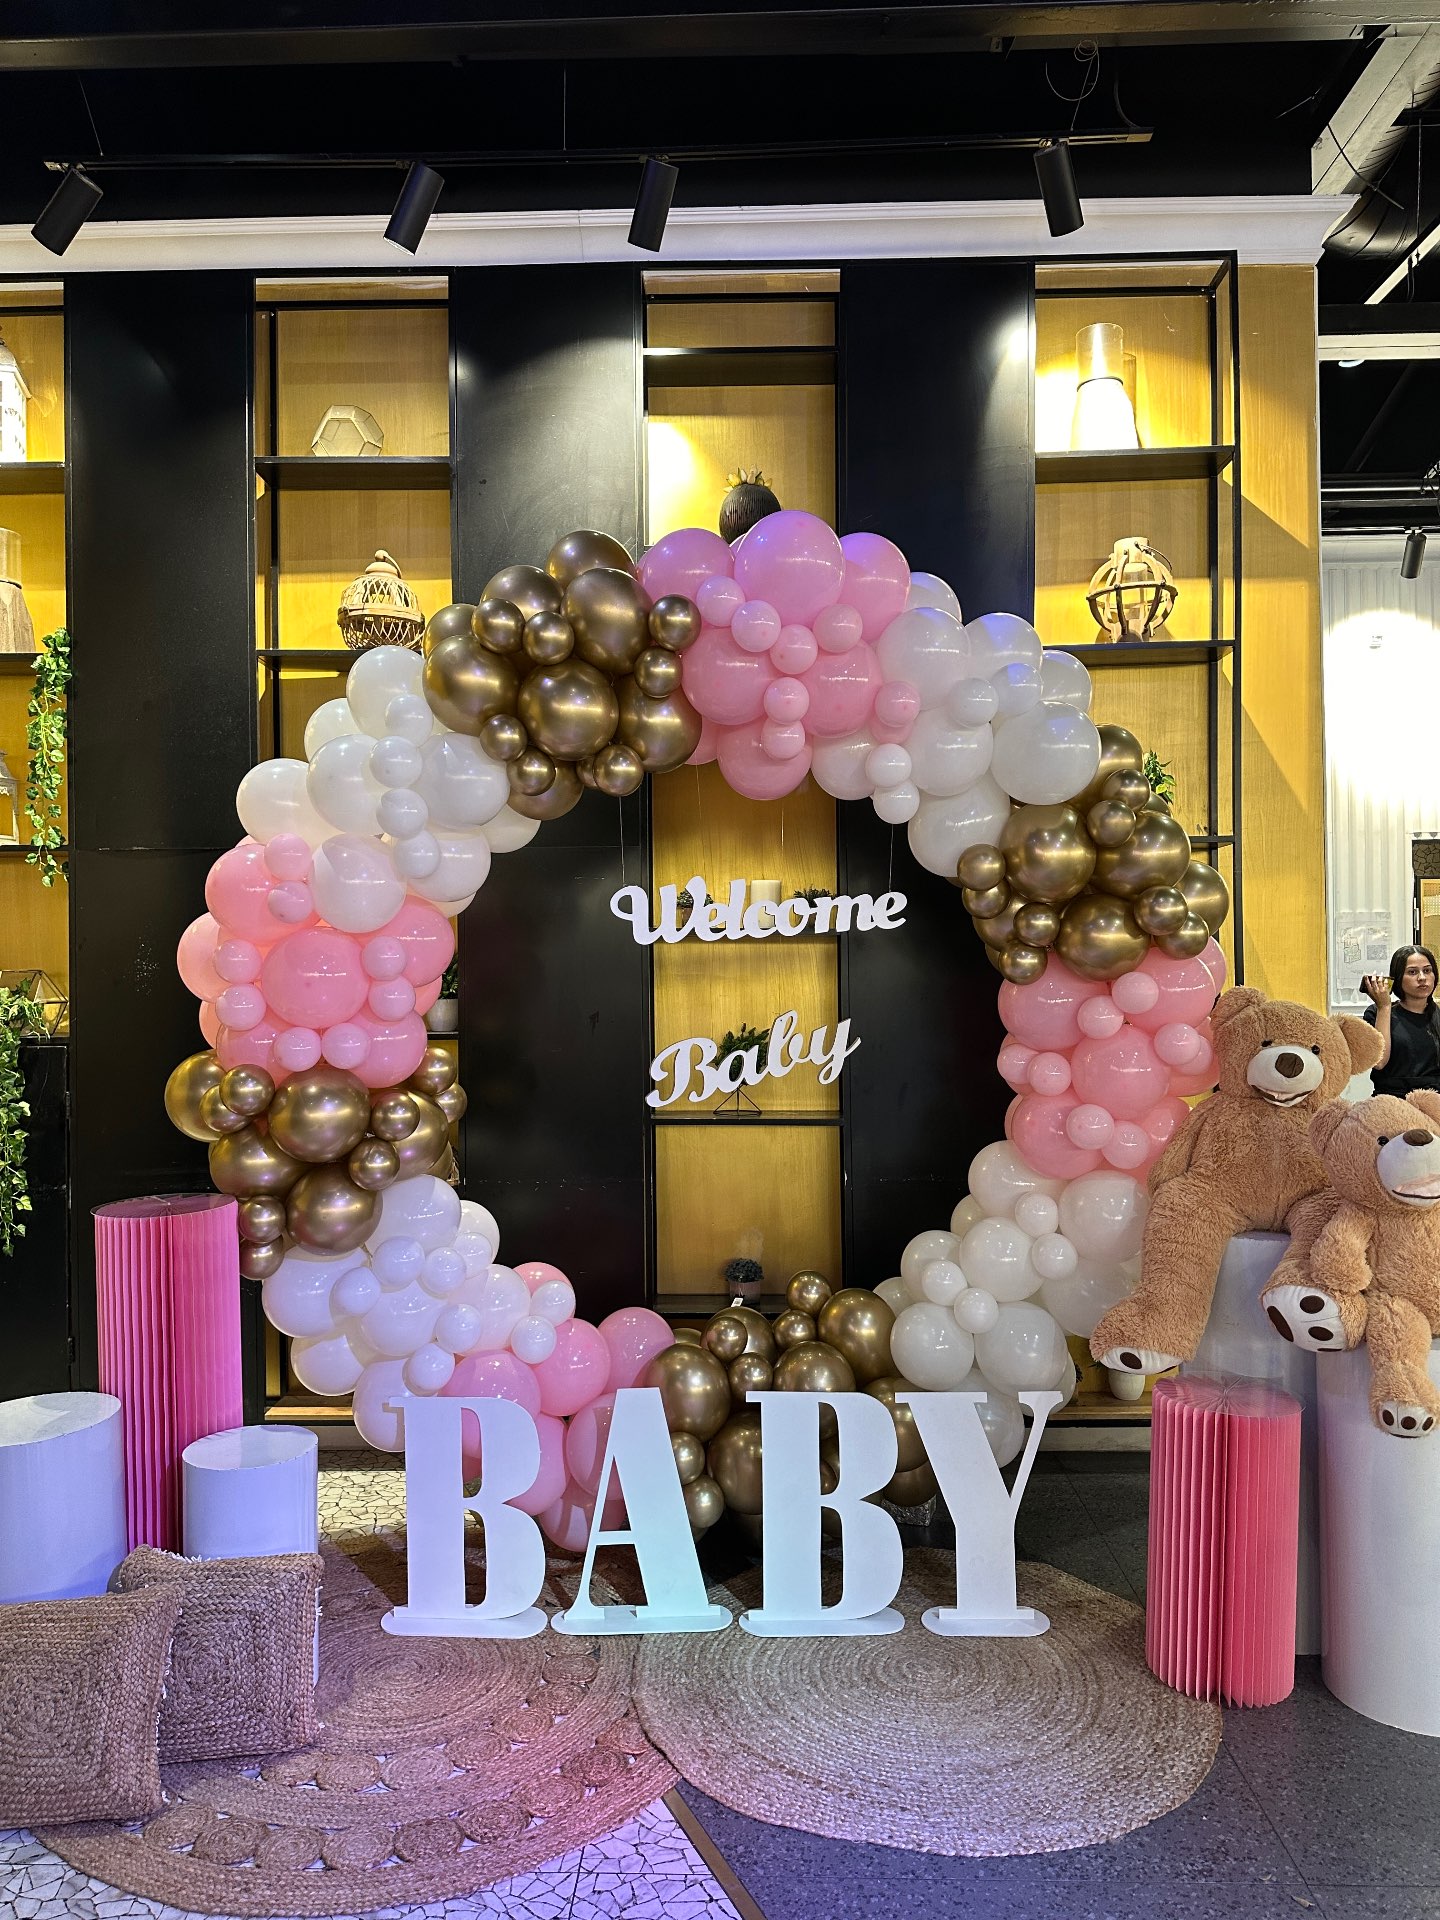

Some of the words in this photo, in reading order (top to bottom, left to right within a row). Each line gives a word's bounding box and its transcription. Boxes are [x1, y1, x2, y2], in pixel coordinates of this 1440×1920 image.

[609, 876, 908, 946] Welcome
[645, 1009, 862, 1108] Baby
[386, 1387, 1064, 1621] BABY
